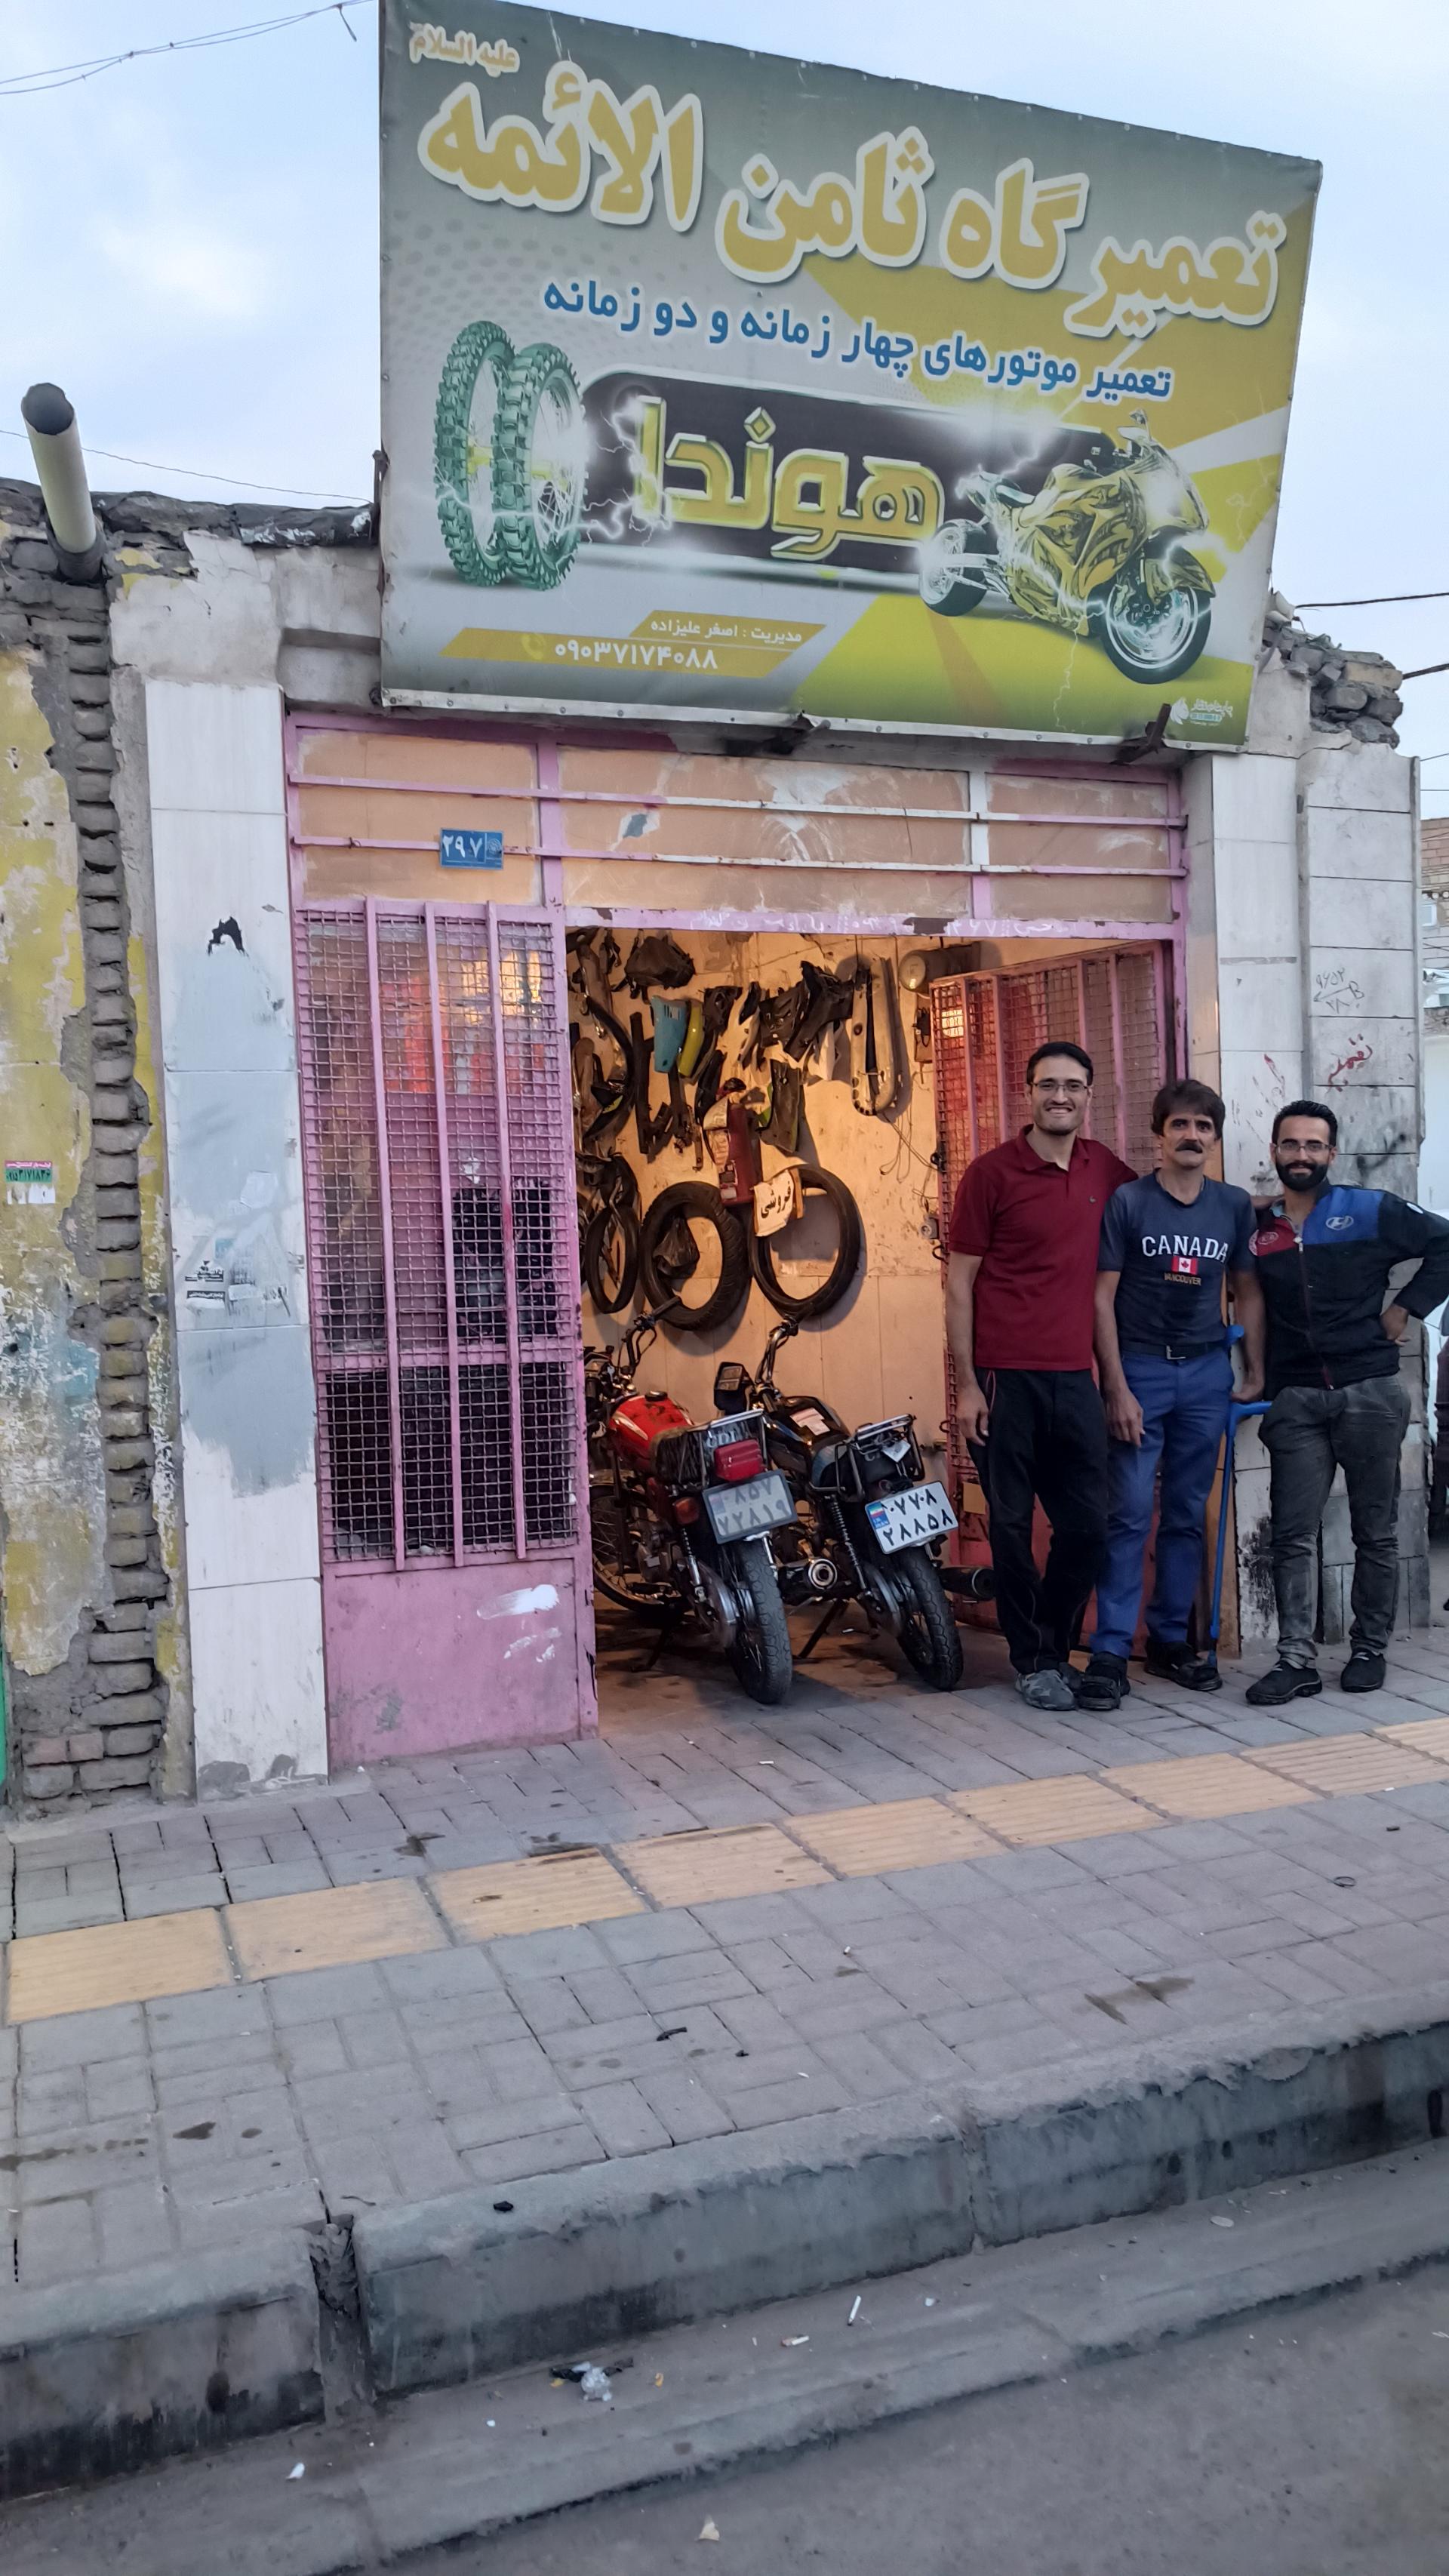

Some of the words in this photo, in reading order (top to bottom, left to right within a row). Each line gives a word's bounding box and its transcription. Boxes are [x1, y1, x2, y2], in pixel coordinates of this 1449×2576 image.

[410, 23, 475, 64] السلام
[477, 38, 520, 76] علیه
[715, 126, 927, 284] ثامن
[544, 281, 641, 331] زمانه
[654, 302, 697, 336] دو
[709, 309, 728, 343] و
[741, 309, 829, 358] زمانه
[842, 322, 913, 377] چهار
[1087, 370, 1172, 401] تعمیر
[633, 395, 945, 562] هوندا
[651, 620, 701, 636] علیزاده
[704, 623, 737, 639] اصغر
[751, 627, 802, 645] مدیریت
[555, 639, 718, 669] ۰۹۰۳۷۱۷۴۰۸۸
[761, 1180, 792, 1219] فروشی
[1142, 1235, 1229, 1263] CANADA
[883, 1509, 953, 1546] ۲۸۸۵۸
